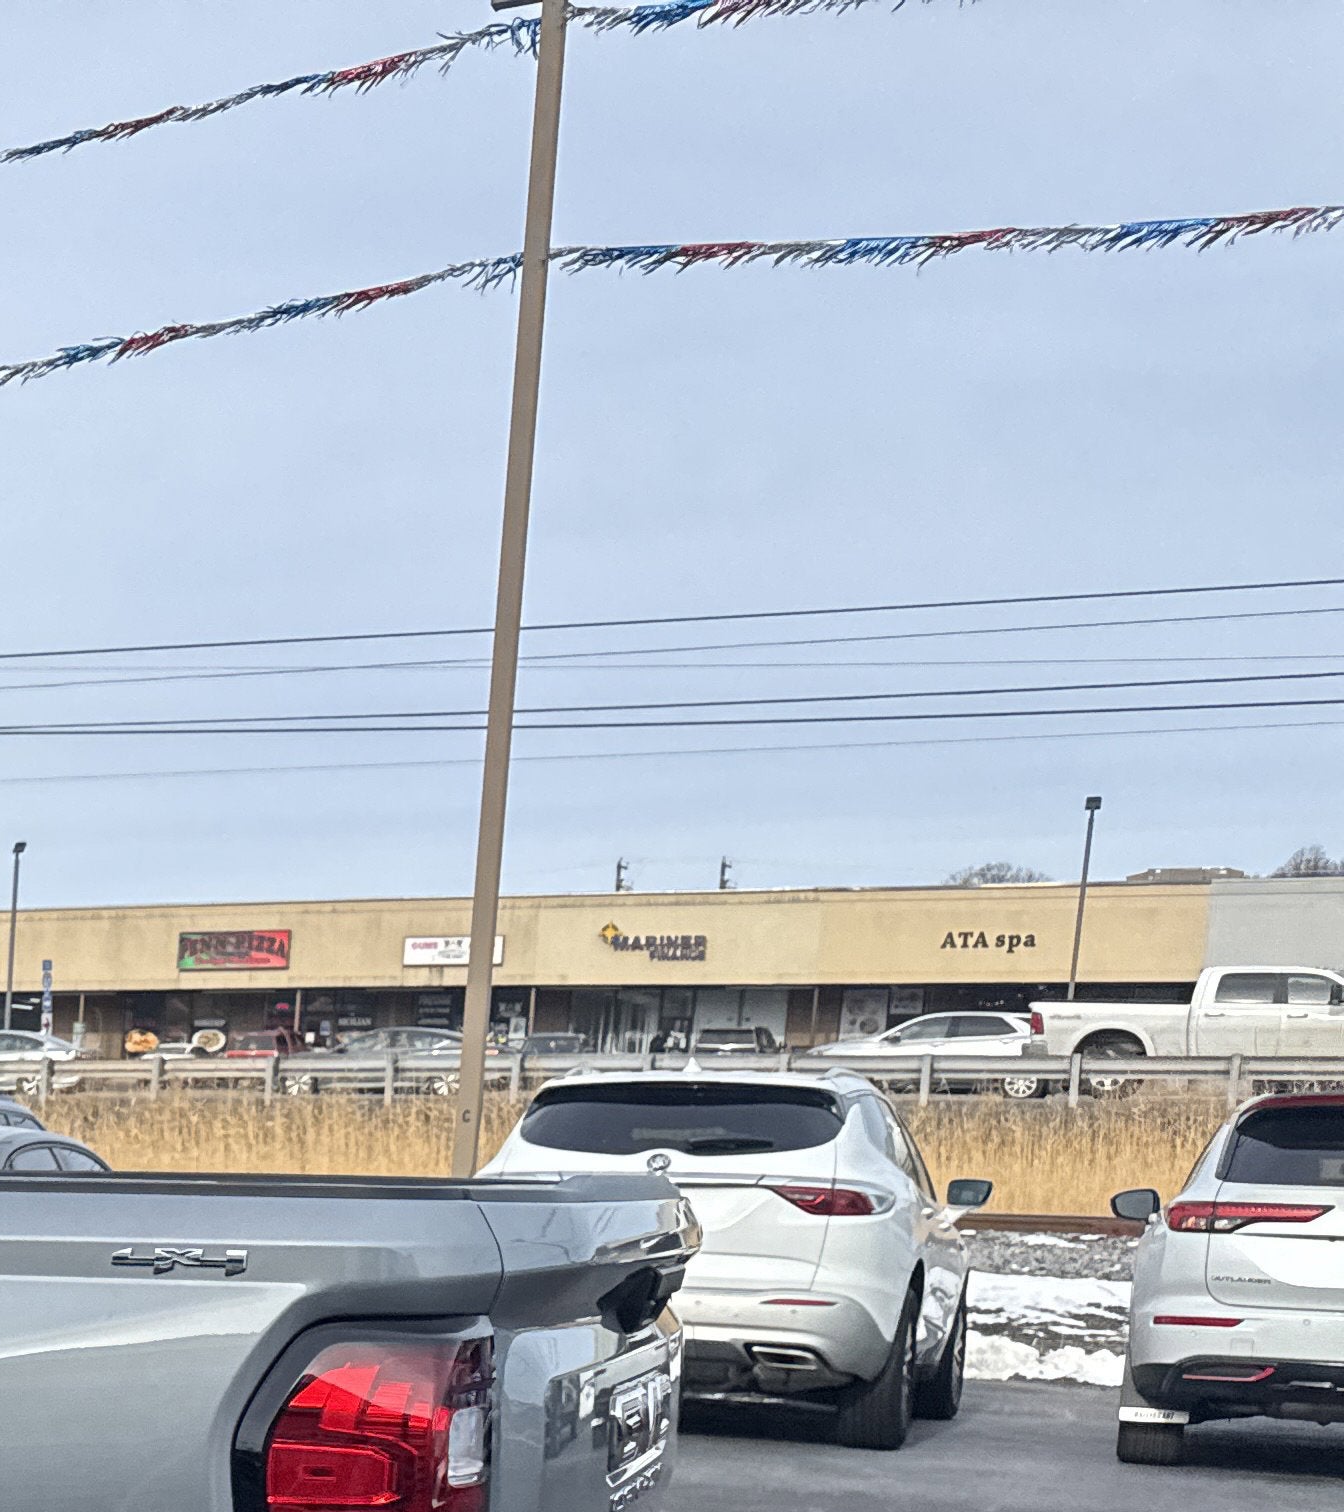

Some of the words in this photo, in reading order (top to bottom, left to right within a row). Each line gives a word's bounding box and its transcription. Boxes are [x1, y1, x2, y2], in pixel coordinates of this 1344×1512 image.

[611, 935, 707, 951] MARINER
[940, 931, 989, 949] ATA
[995, 934, 1036, 953] spa
[462, 1108, 471, 1123] C
